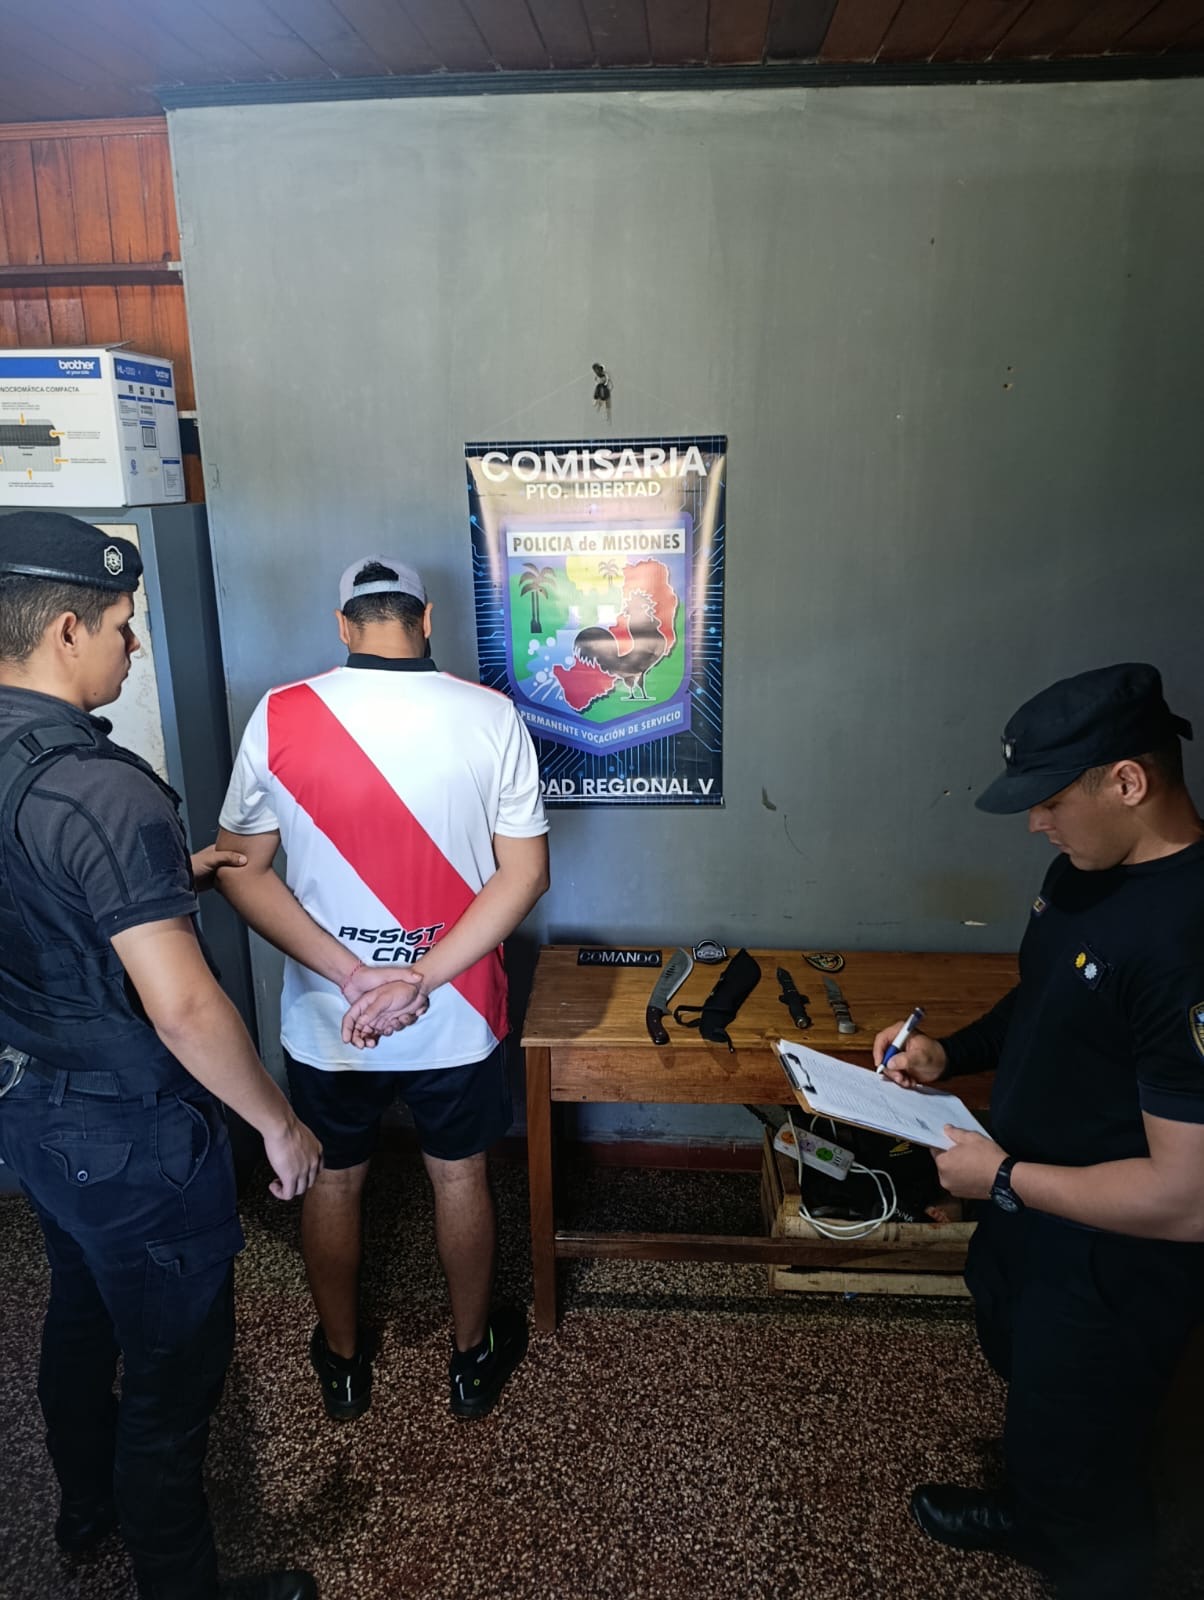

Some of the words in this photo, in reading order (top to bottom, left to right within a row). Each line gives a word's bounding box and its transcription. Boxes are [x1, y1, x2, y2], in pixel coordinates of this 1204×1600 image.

[58, 360, 95, 370] brother
[481, 446, 707, 482] COMISARIA
[526, 483, 568, 499] PTO.
[575, 481, 661, 498] LIBERTAD
[513, 536, 573, 552] POLICIA
[579, 536, 597, 551] de
[603, 533, 680, 551] MISIONES
[520, 710, 579, 736] PERMANENTE
[581, 728, 626, 744] VOCACIÓN
[628, 724, 639, 735] DE
[641, 710, 681, 731] SERVICIO
[583, 777, 693, 795] REGIONAL
[698, 778, 715, 795] V
[338, 923, 444, 946] ASSIST
[580, 951, 660, 964] COMANDO
